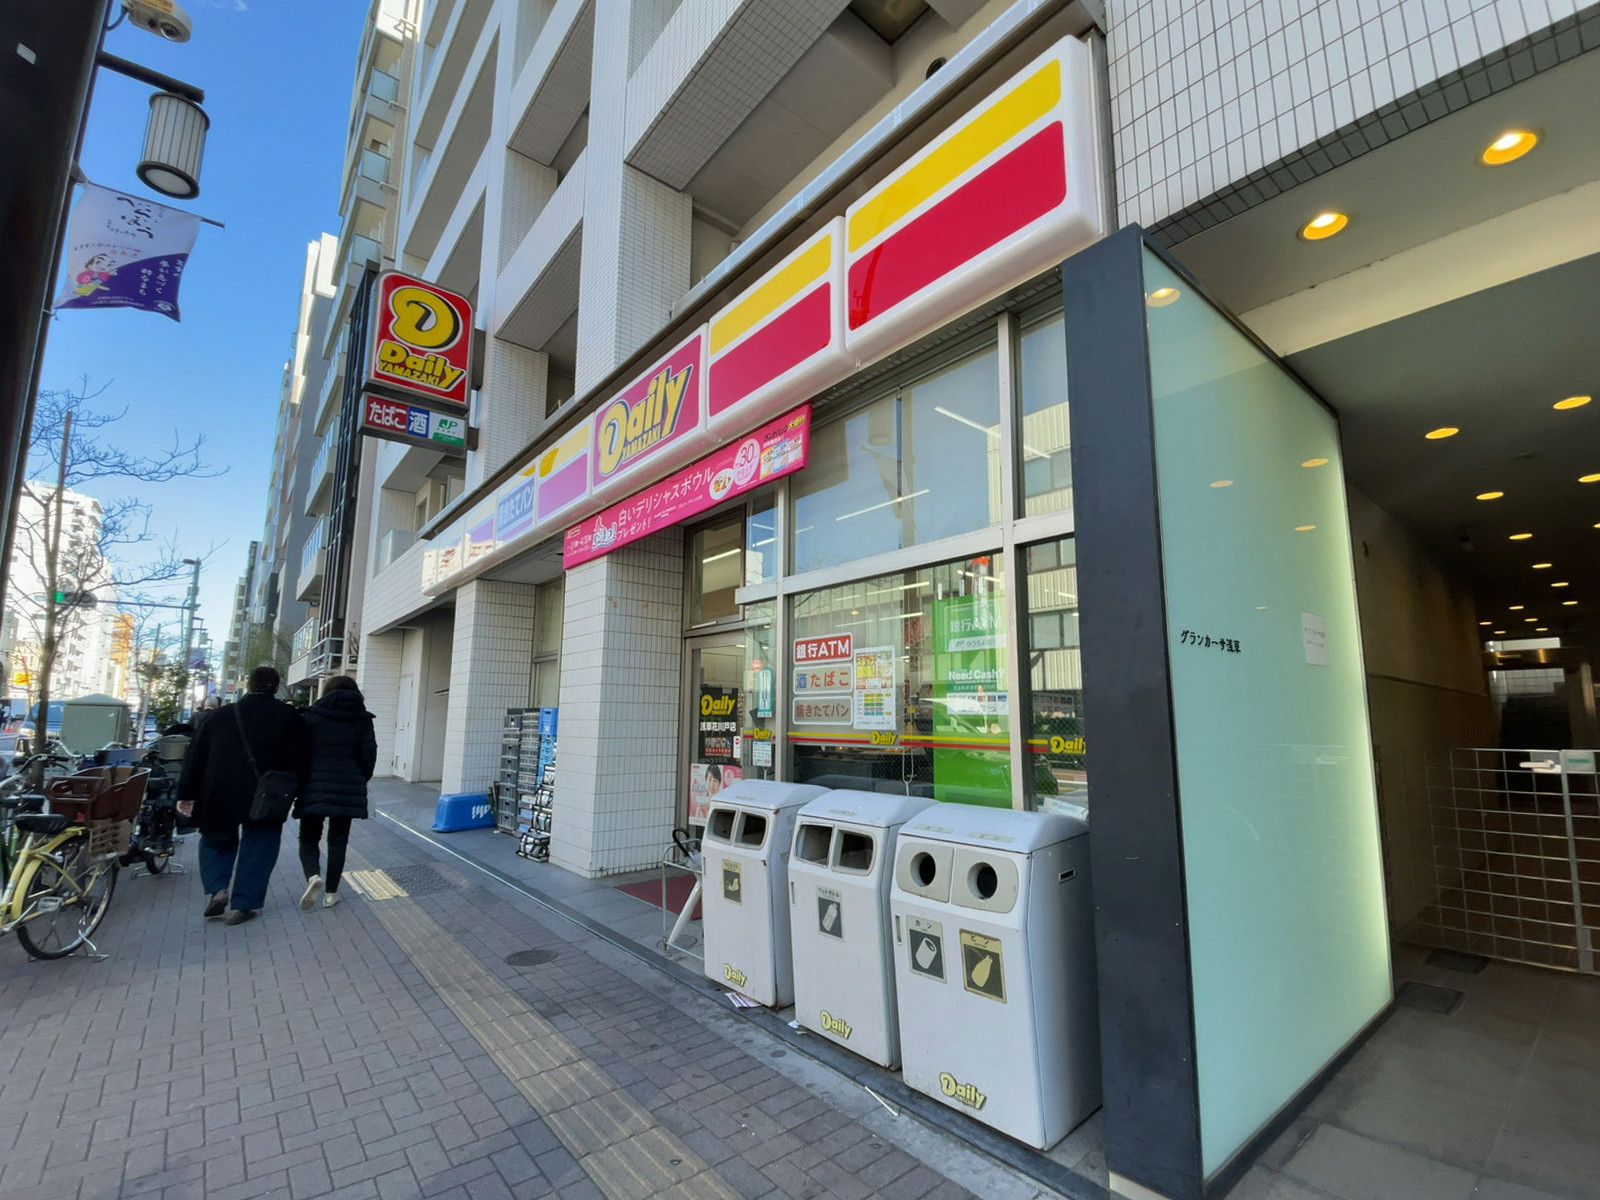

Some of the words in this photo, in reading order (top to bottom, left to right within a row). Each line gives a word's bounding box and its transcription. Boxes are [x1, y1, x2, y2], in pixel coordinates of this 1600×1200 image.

[379, 340, 465, 389] Daily
[379, 360, 440, 386] YAMAZAKI
[368, 401, 407, 430] たばこ
[408, 410, 428, 435] 酒
[598, 365, 693, 476] Daily
[618, 467, 715, 527] 白いデリシャスボウル
[796, 639, 849, 659] 銀行ATM
[797, 673, 807, 688] 酒
[811, 670, 849, 688] たばこ
[948, 671, 973, 681] Need
[974, 669, 1005, 680] Cash?
[701, 694, 736, 716] Daily
[796, 703, 849, 718] 焼きたてパン
[753, 728, 771, 740] Daily
[871, 730, 897, 745] Daily
[723, 963, 748, 988] Daily
[820, 1010, 852, 1040] Daily
[939, 1071, 988, 1111] Daily
